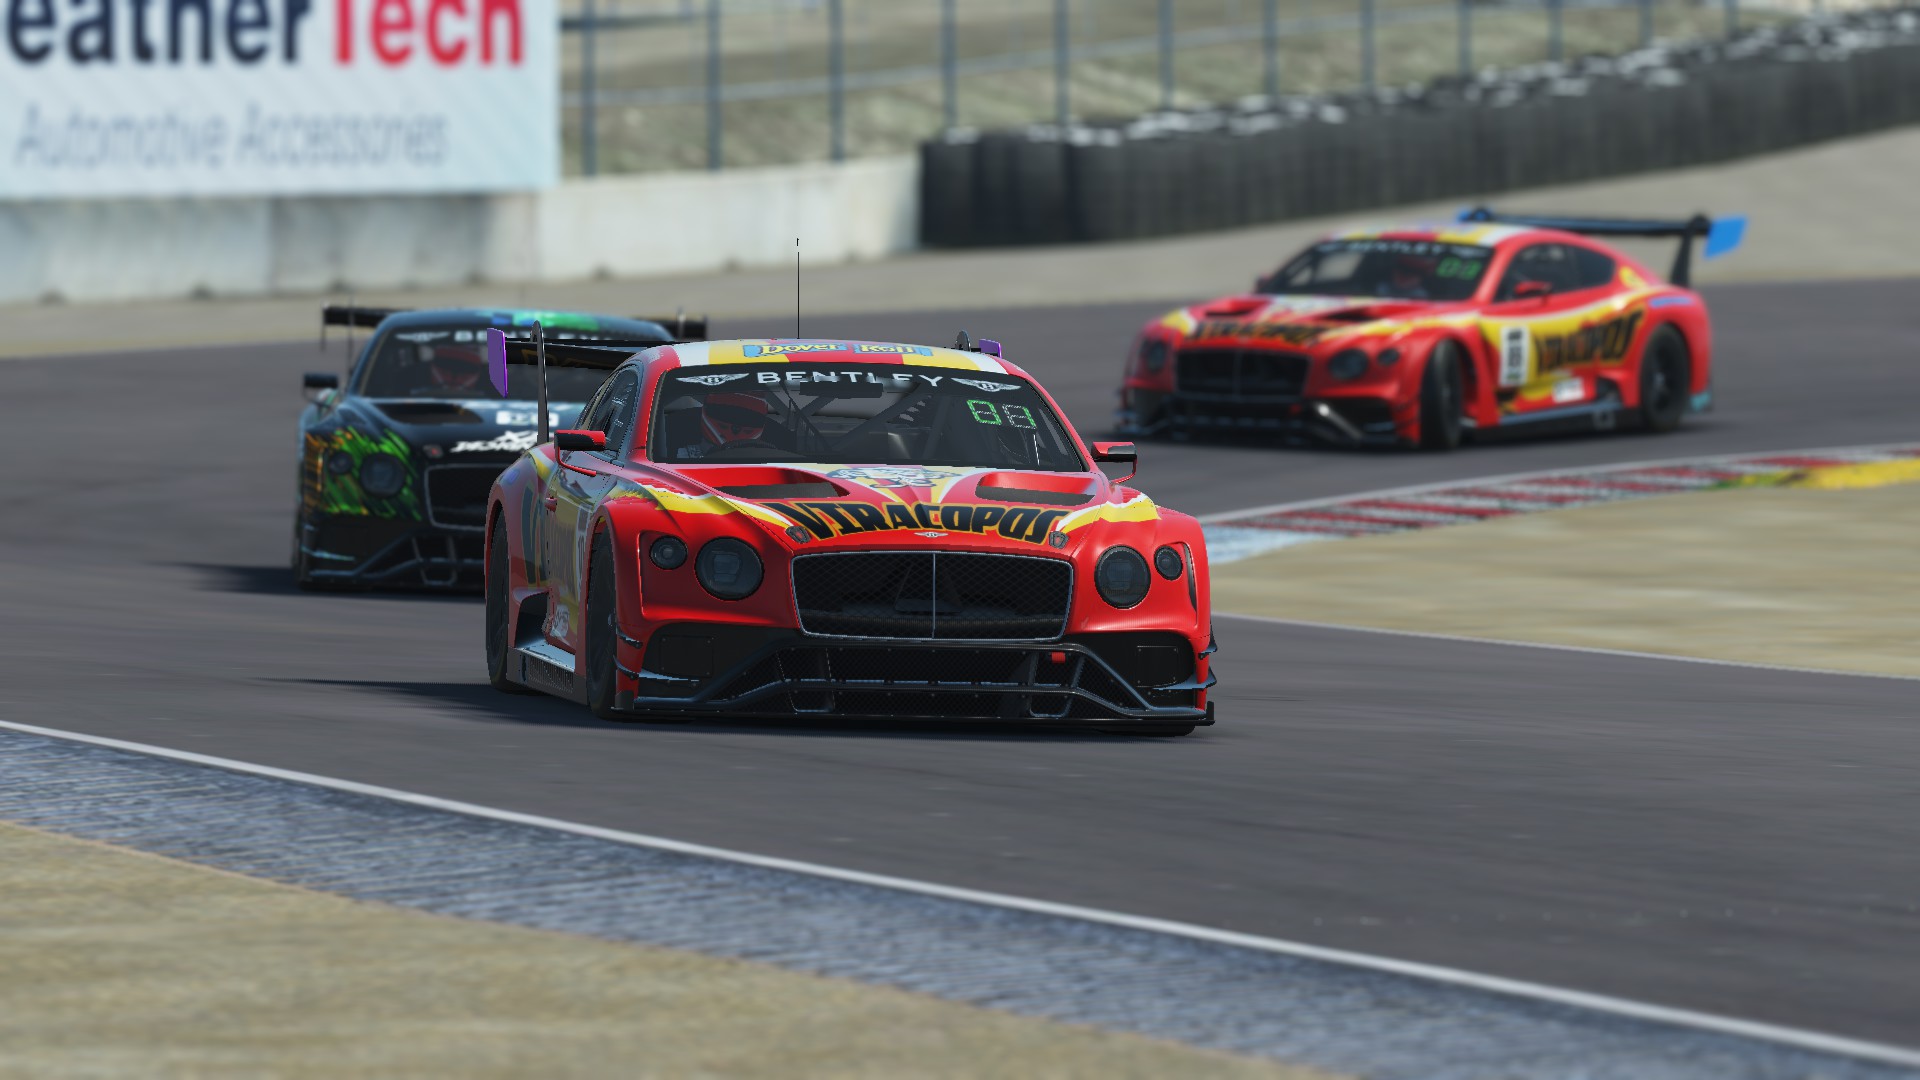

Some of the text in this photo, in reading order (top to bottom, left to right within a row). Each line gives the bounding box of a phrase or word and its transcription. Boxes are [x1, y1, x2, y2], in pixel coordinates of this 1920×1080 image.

[14, 105, 448, 168] Automotive Accessories
[757, 371, 943, 387] BENTLEY
[763, 500, 1071, 545] VIRACOPOS
